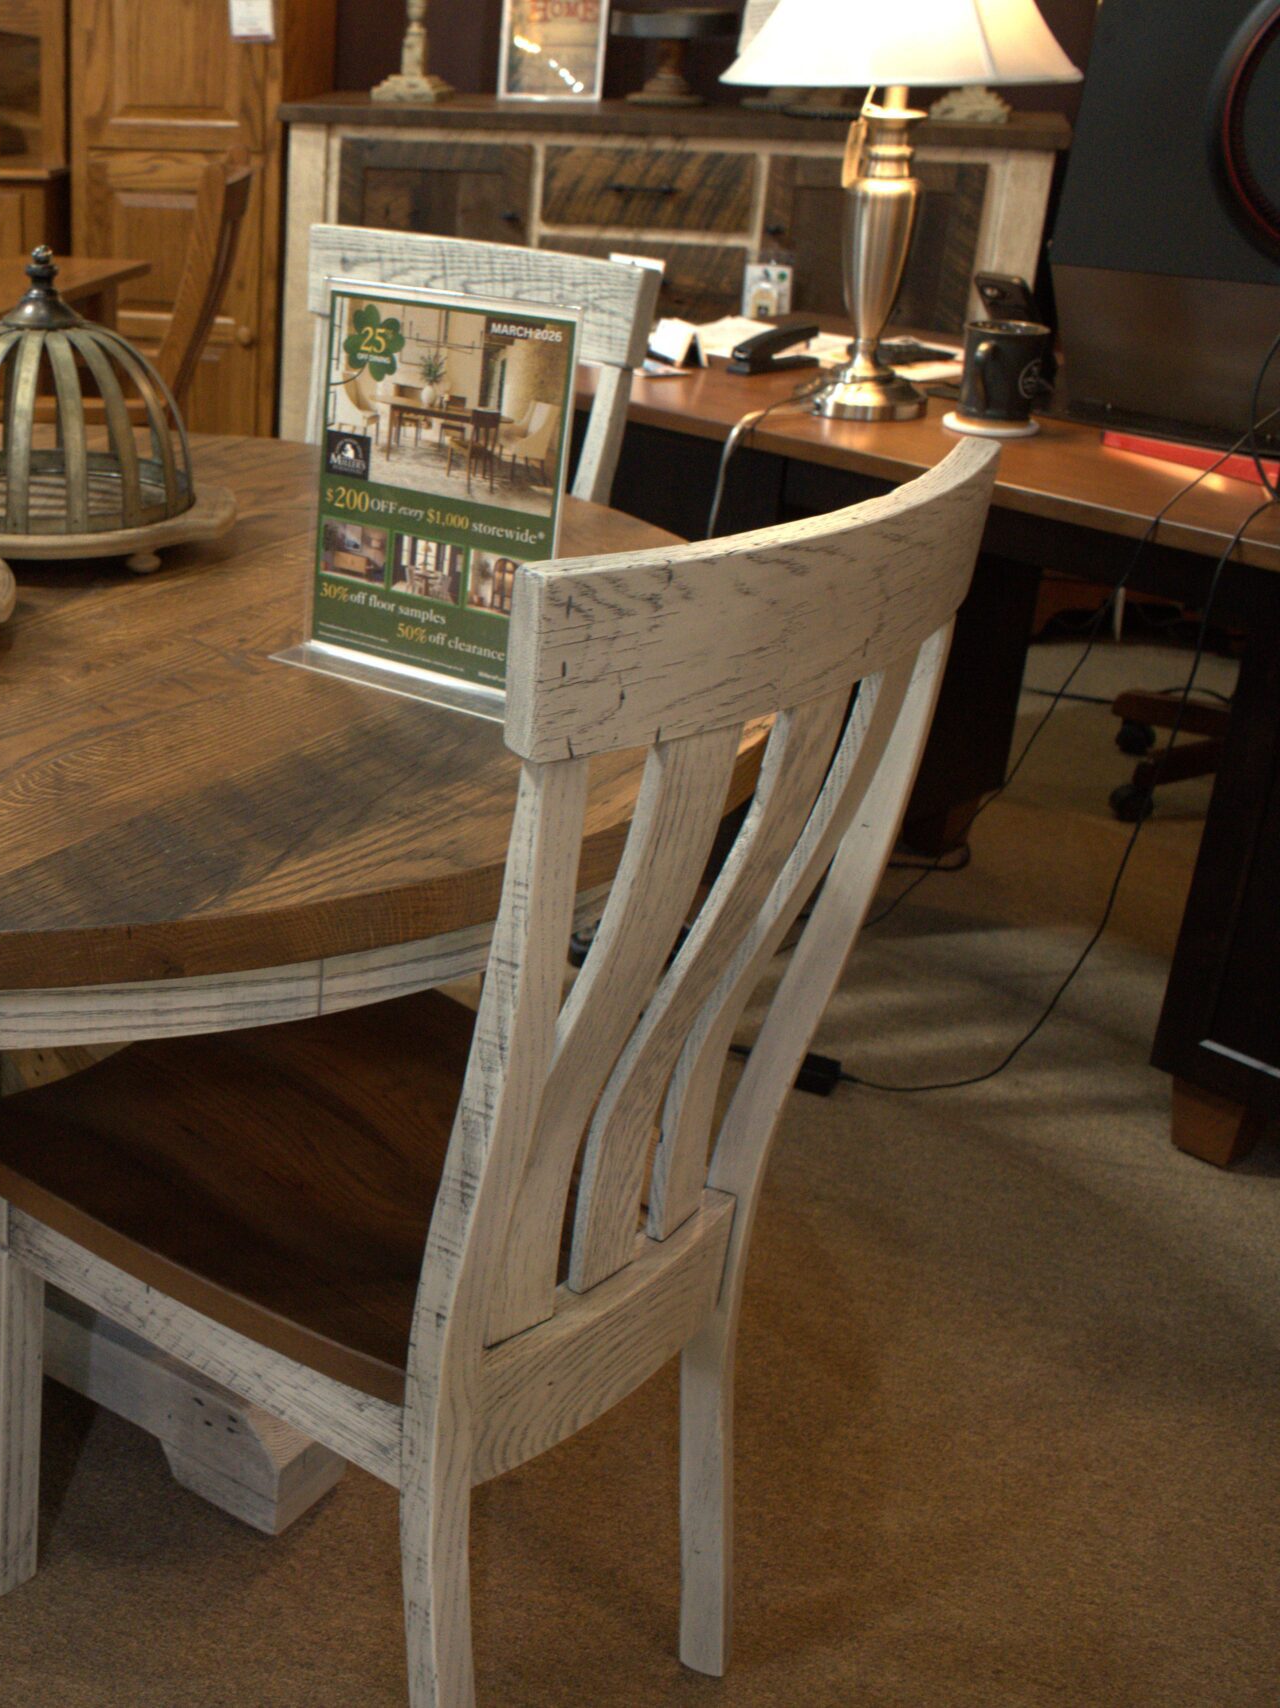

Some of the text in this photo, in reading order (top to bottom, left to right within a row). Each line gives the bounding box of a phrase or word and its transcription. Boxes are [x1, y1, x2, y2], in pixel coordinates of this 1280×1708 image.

[490, 322, 563, 343] MARCH 2026
[326, 486, 370, 513] $200
[370, 498, 397, 514] OFF
[397, 506, 425, 521] every
[426, 507, 469, 531] $1,000
[320, 582, 447, 626] 30% off floor samples
[396, 622, 427, 645] 50%
[428, 632, 447, 647] off
[447, 636, 506, 662] clearance
